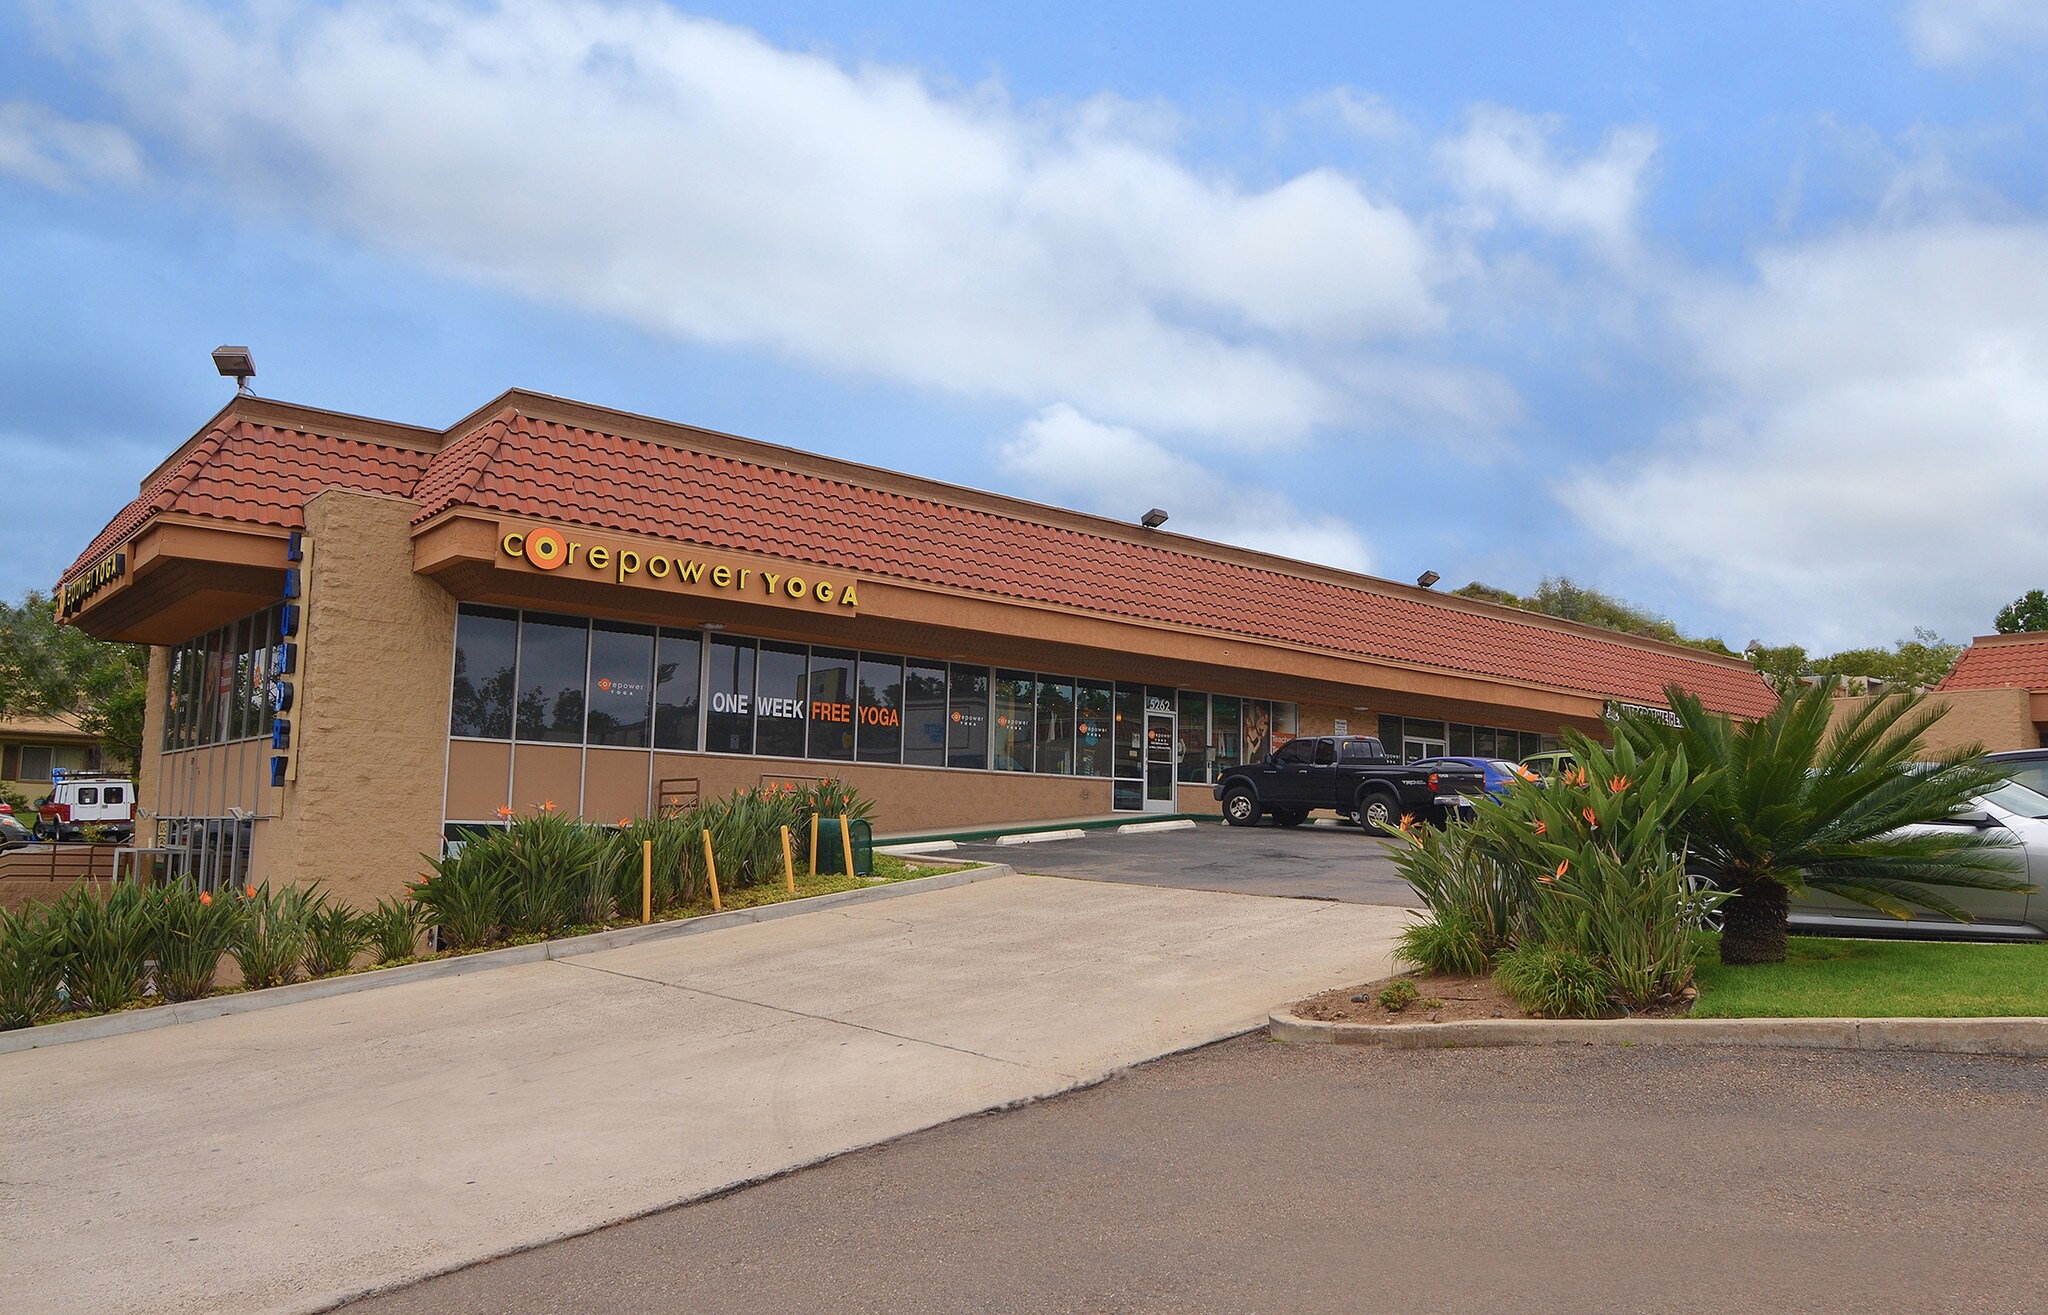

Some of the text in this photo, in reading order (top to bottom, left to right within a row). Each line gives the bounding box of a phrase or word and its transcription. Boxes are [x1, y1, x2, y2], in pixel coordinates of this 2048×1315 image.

[94, 553, 120, 586] YOGA
[502, 527, 859, 607] corepower YOGA
[270, 532, 303, 788] LAUNDRY
[597, 678, 644, 691] corepower
[712, 692, 899, 727] ONE WEEK FREE YOGA
[1150, 699, 1170, 711] 5262
